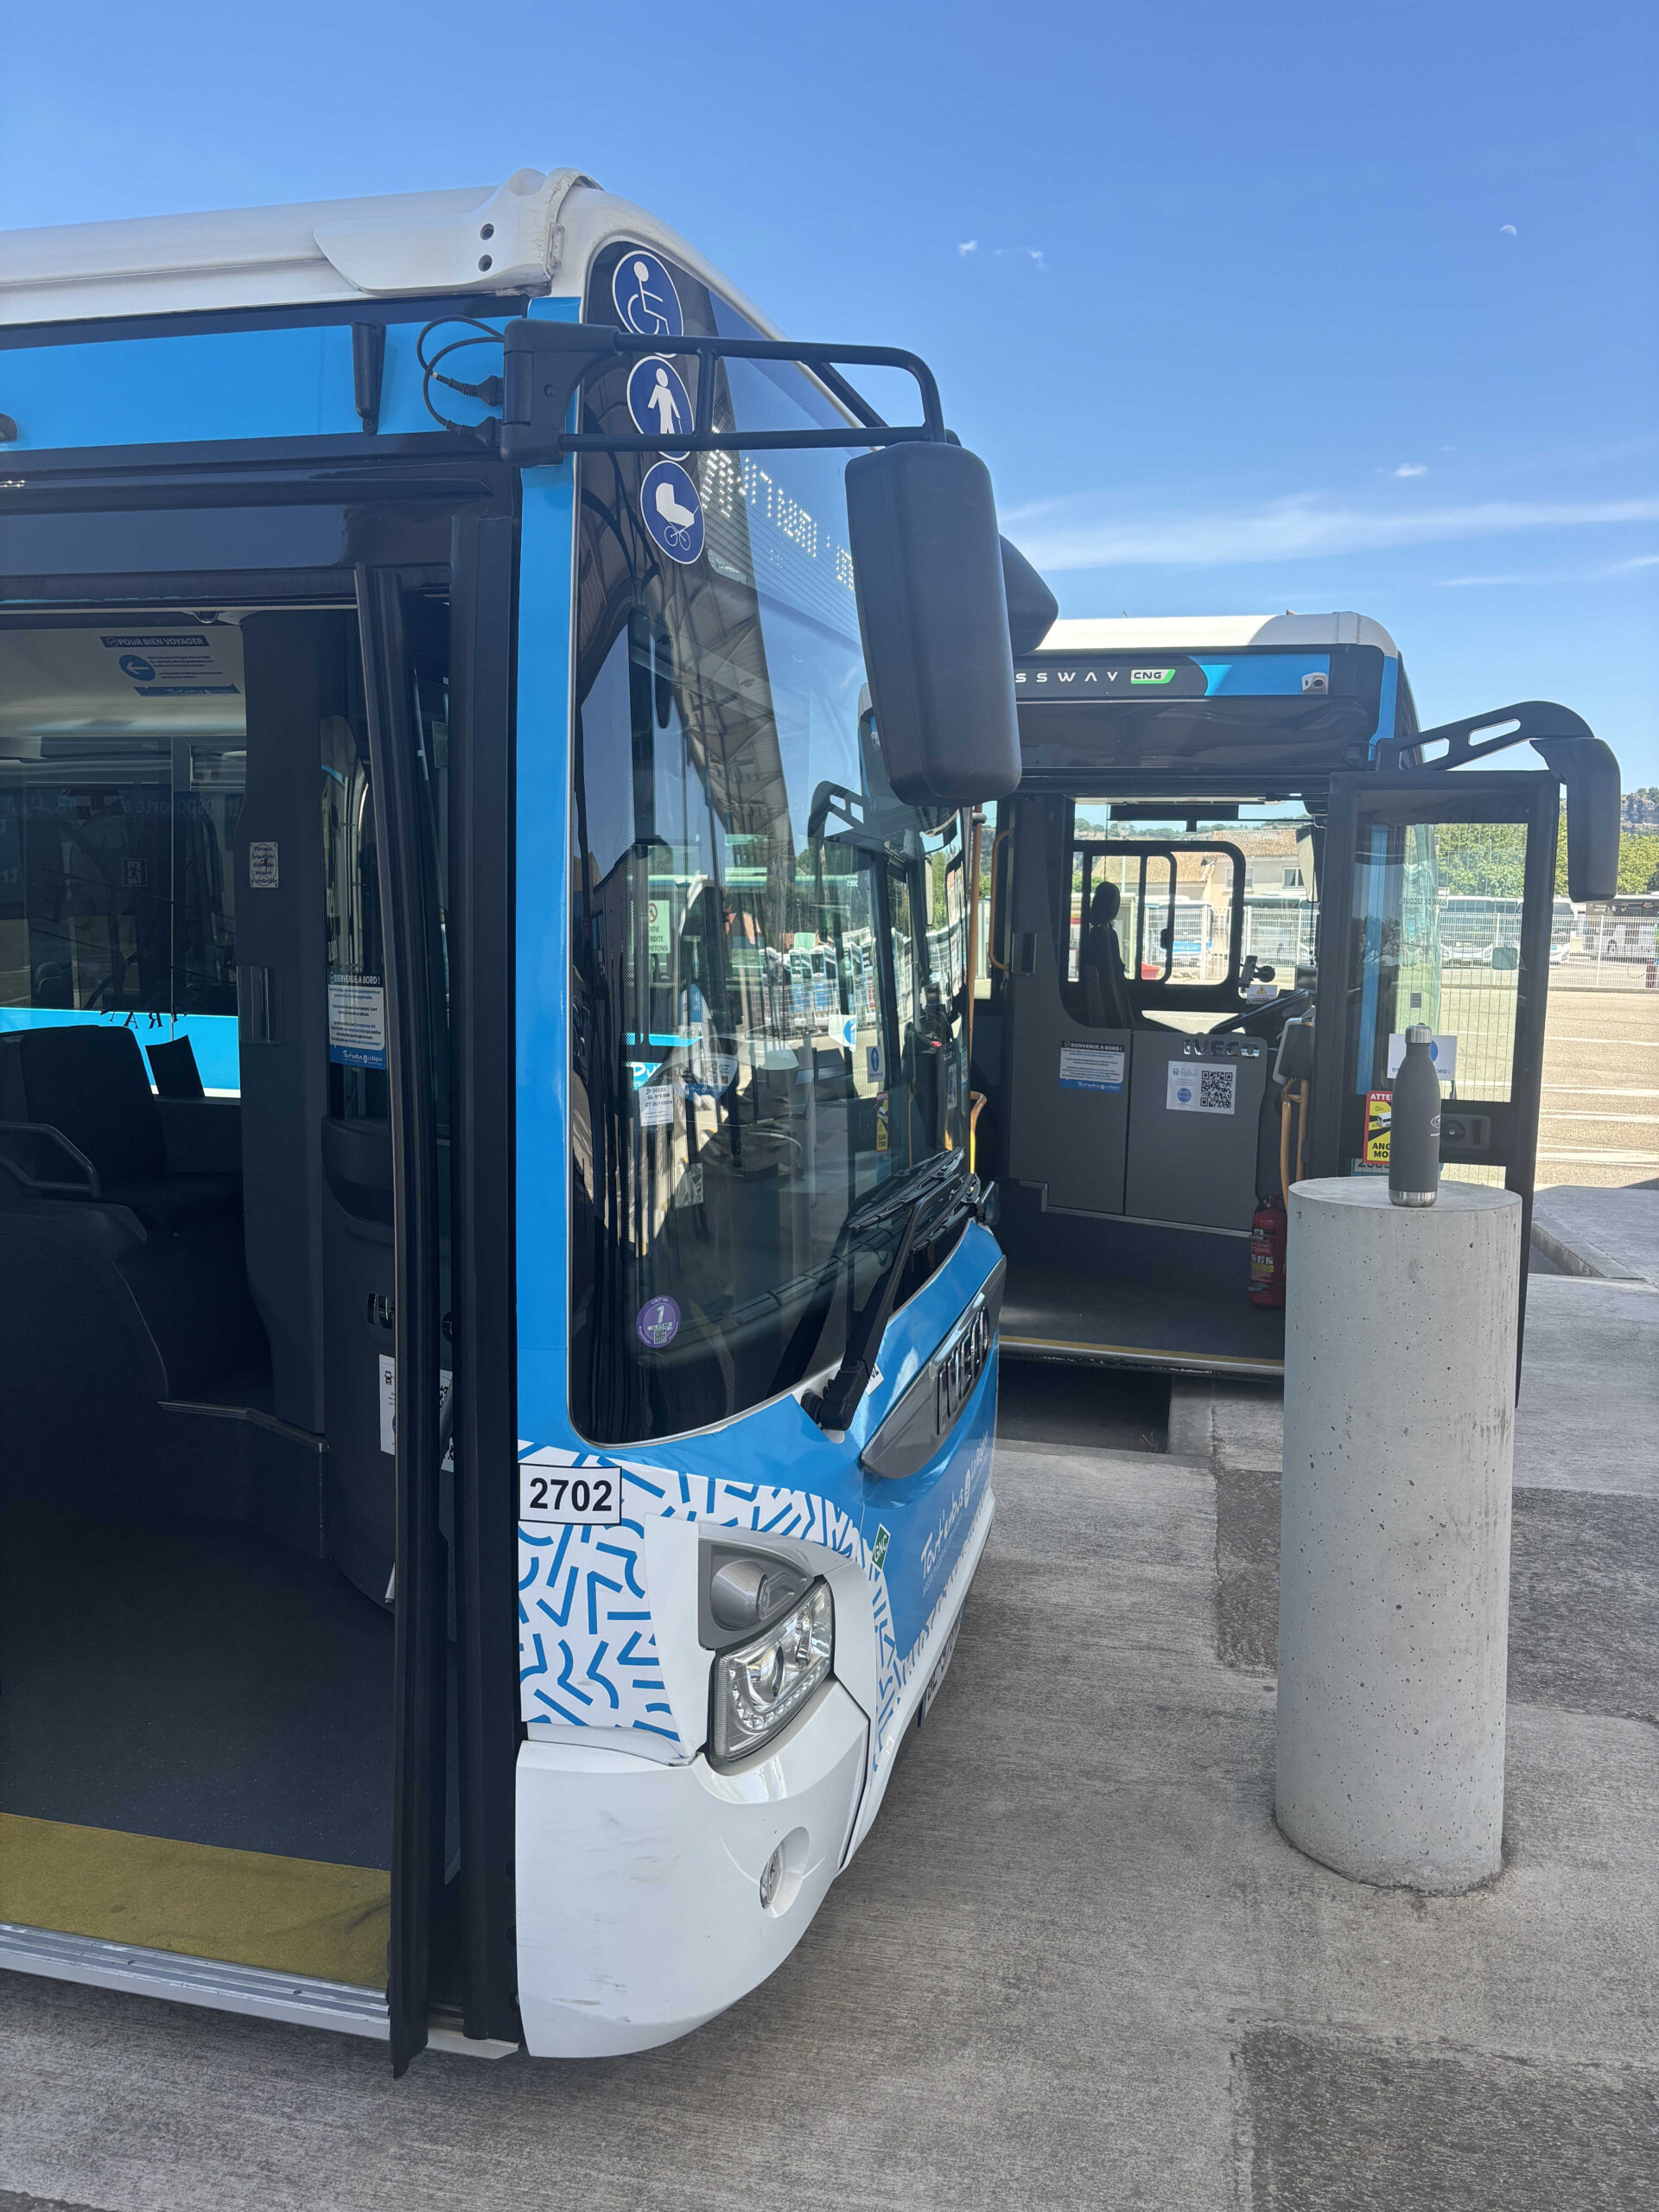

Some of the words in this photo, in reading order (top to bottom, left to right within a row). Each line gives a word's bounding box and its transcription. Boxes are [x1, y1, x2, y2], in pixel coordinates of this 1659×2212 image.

[1015, 672, 1118, 683] SSWAY
[1134, 671, 1162, 680] CNG
[334, 973, 358, 984] BIENVENUE
[363, 976, 378, 985] BORD
[1183, 1039, 1260, 1057] IVECO
[657, 1305, 664, 1324] 1
[529, 1477, 613, 1511] 2702
[874, 1534, 888, 1562] GNC
